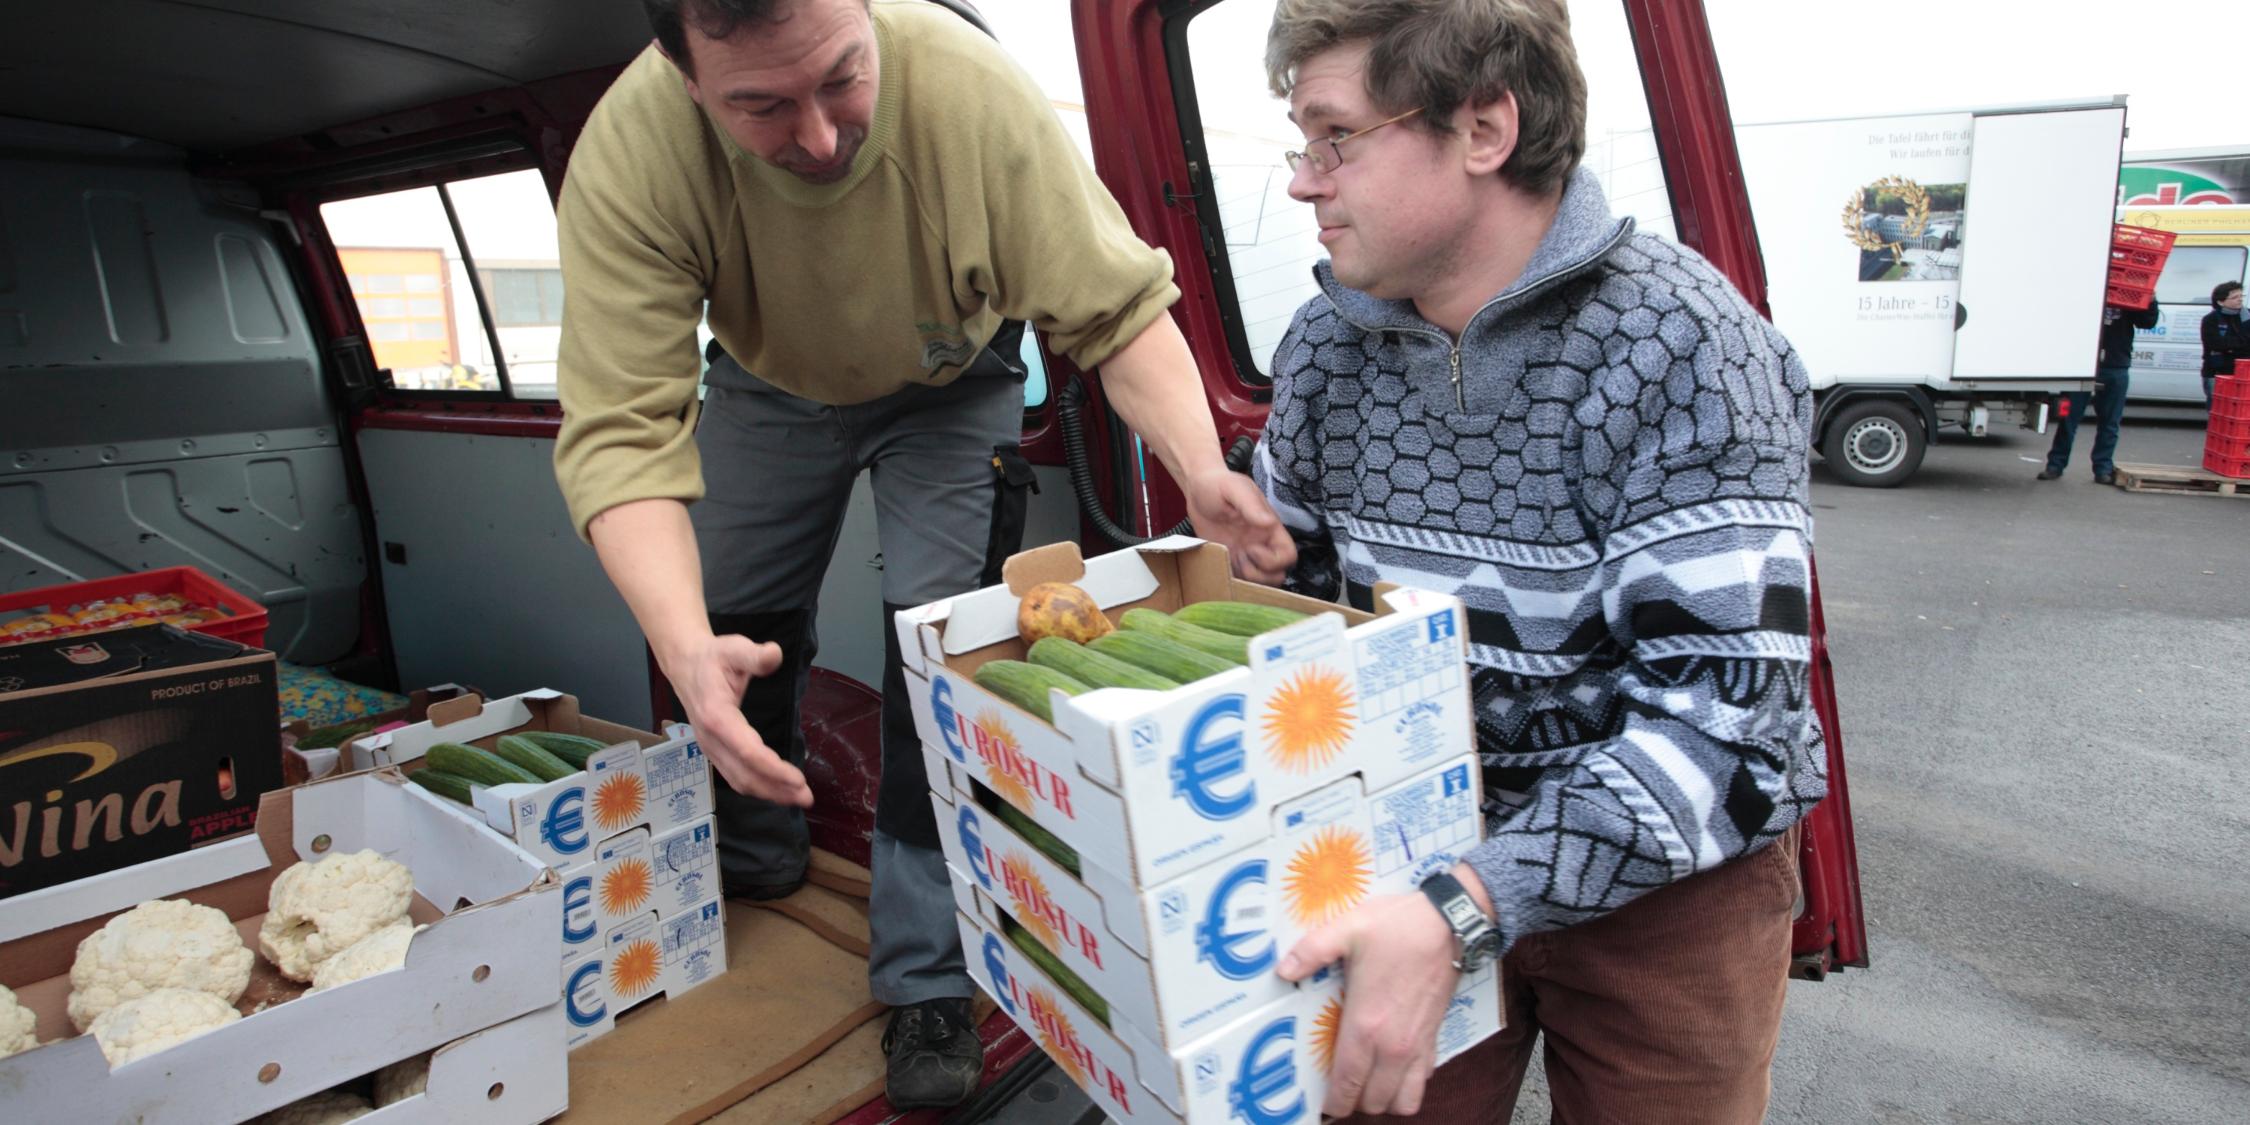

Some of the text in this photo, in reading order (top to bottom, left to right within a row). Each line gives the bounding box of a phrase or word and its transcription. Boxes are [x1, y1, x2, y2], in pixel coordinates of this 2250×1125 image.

[1868, 134, 1885, 145] Die
[1888, 132, 1911, 144] Tafel
[1914, 130, 1939, 142] fährt
[1942, 129, 1957, 141] für
[1889, 148, 1909, 159] Wir
[1910, 147, 1942, 159] laufen
[1945, 145, 1960, 157] für
[1858, 296, 1872, 310] 15
[1878, 296, 1916, 311] Jahre
[1935, 295, 1950, 309] 15
[151, 674, 261, 701] PRODUCT OF BRAZIL
